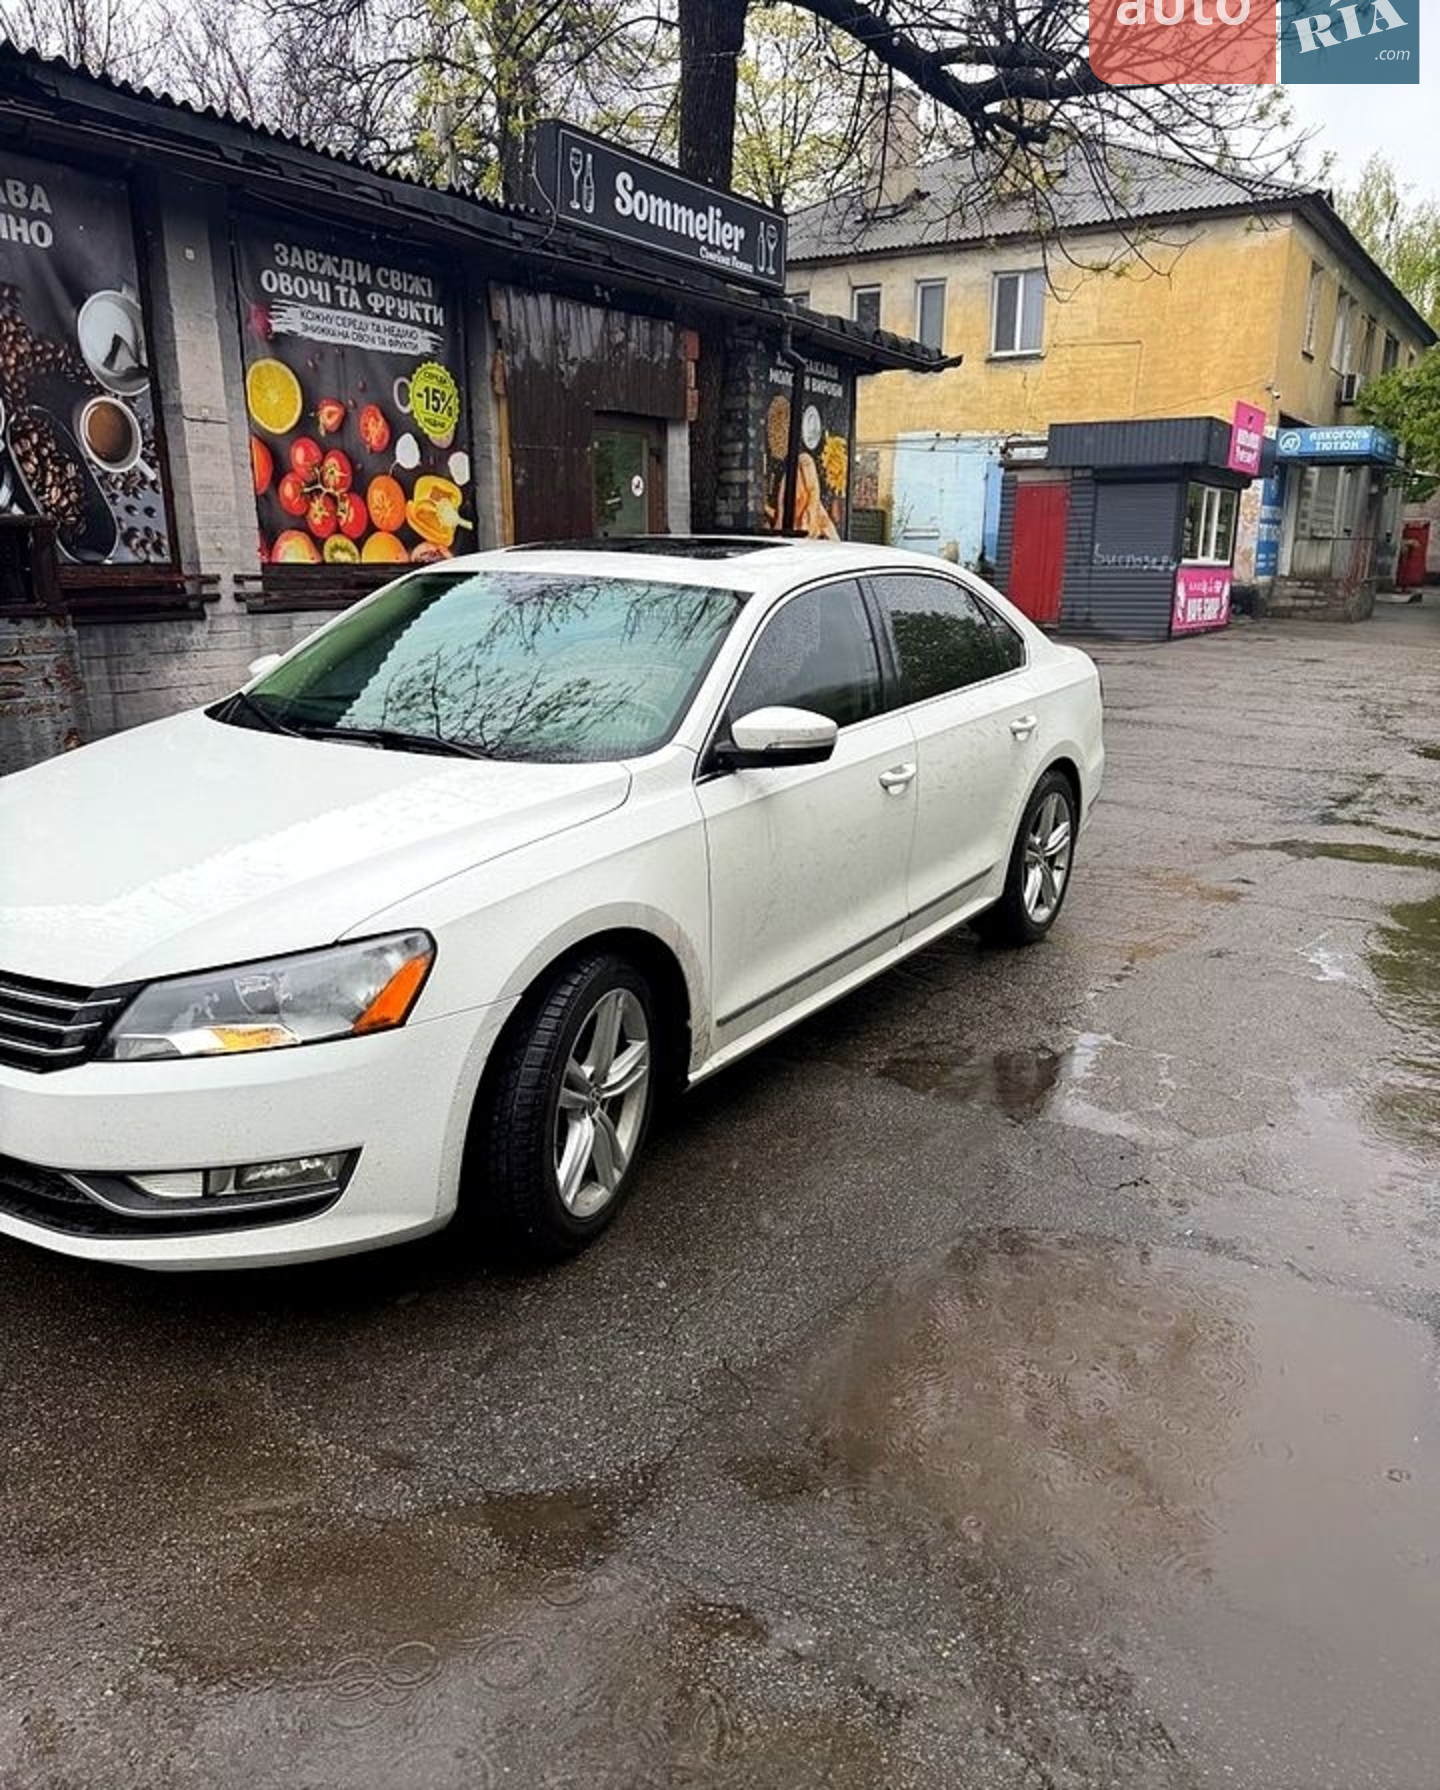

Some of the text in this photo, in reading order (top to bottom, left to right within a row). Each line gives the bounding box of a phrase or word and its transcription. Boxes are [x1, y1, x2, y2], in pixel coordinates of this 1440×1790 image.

[0, 178, 53, 215] ВА
[614, 171, 746, 253] Sommelier
[273, 242, 433, 298] ЗАВЖДИ СВІЖІ
[260, 269, 445, 327] ОВОЧІ ТА ФРУКТИ
[416, 385, 453, 417] -15%
[1309, 428, 1370, 442] АЛКОГОЛЬ
[1314, 440, 1360, 451] ТЮТЮН
